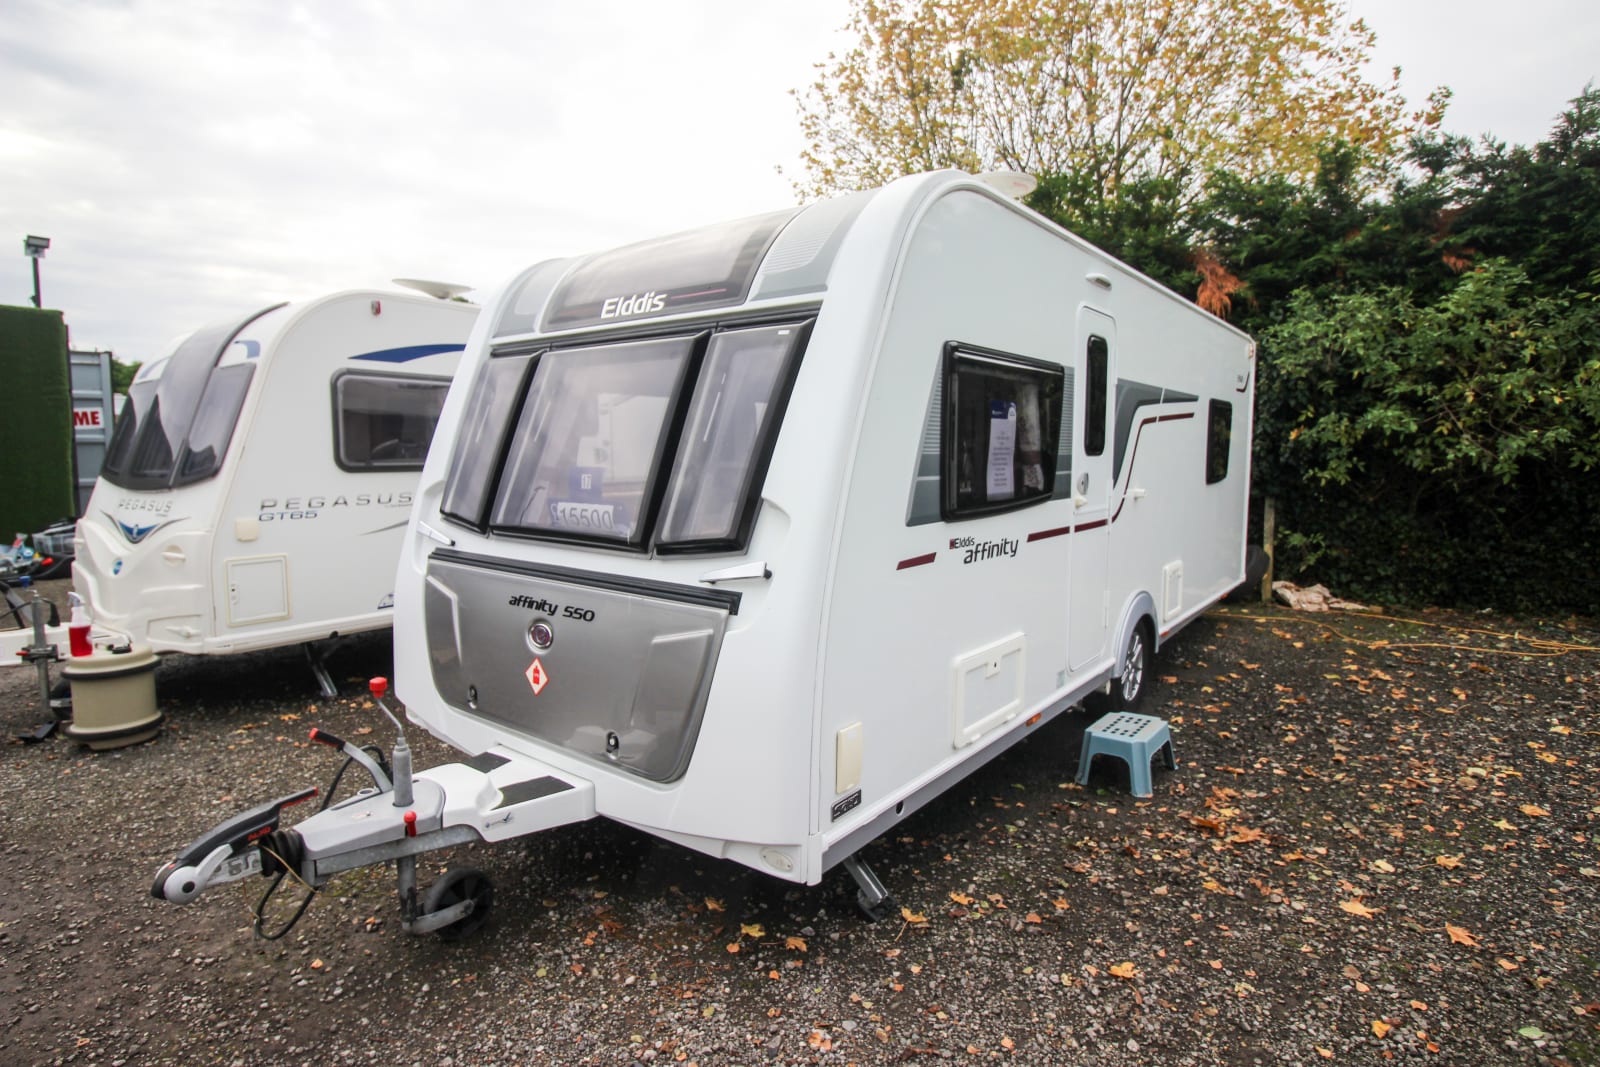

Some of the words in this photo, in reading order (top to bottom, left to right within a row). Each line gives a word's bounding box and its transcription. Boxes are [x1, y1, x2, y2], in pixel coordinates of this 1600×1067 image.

[601, 291, 668, 319] Elddis
[118, 499, 173, 513] PEGASUS
[260, 492, 413, 511] PEGASUS
[258, 510, 318, 522] GT65
[963, 538, 1019, 564] affinity
[508, 595, 558, 616] affinity
[562, 605, 595, 622] 550
